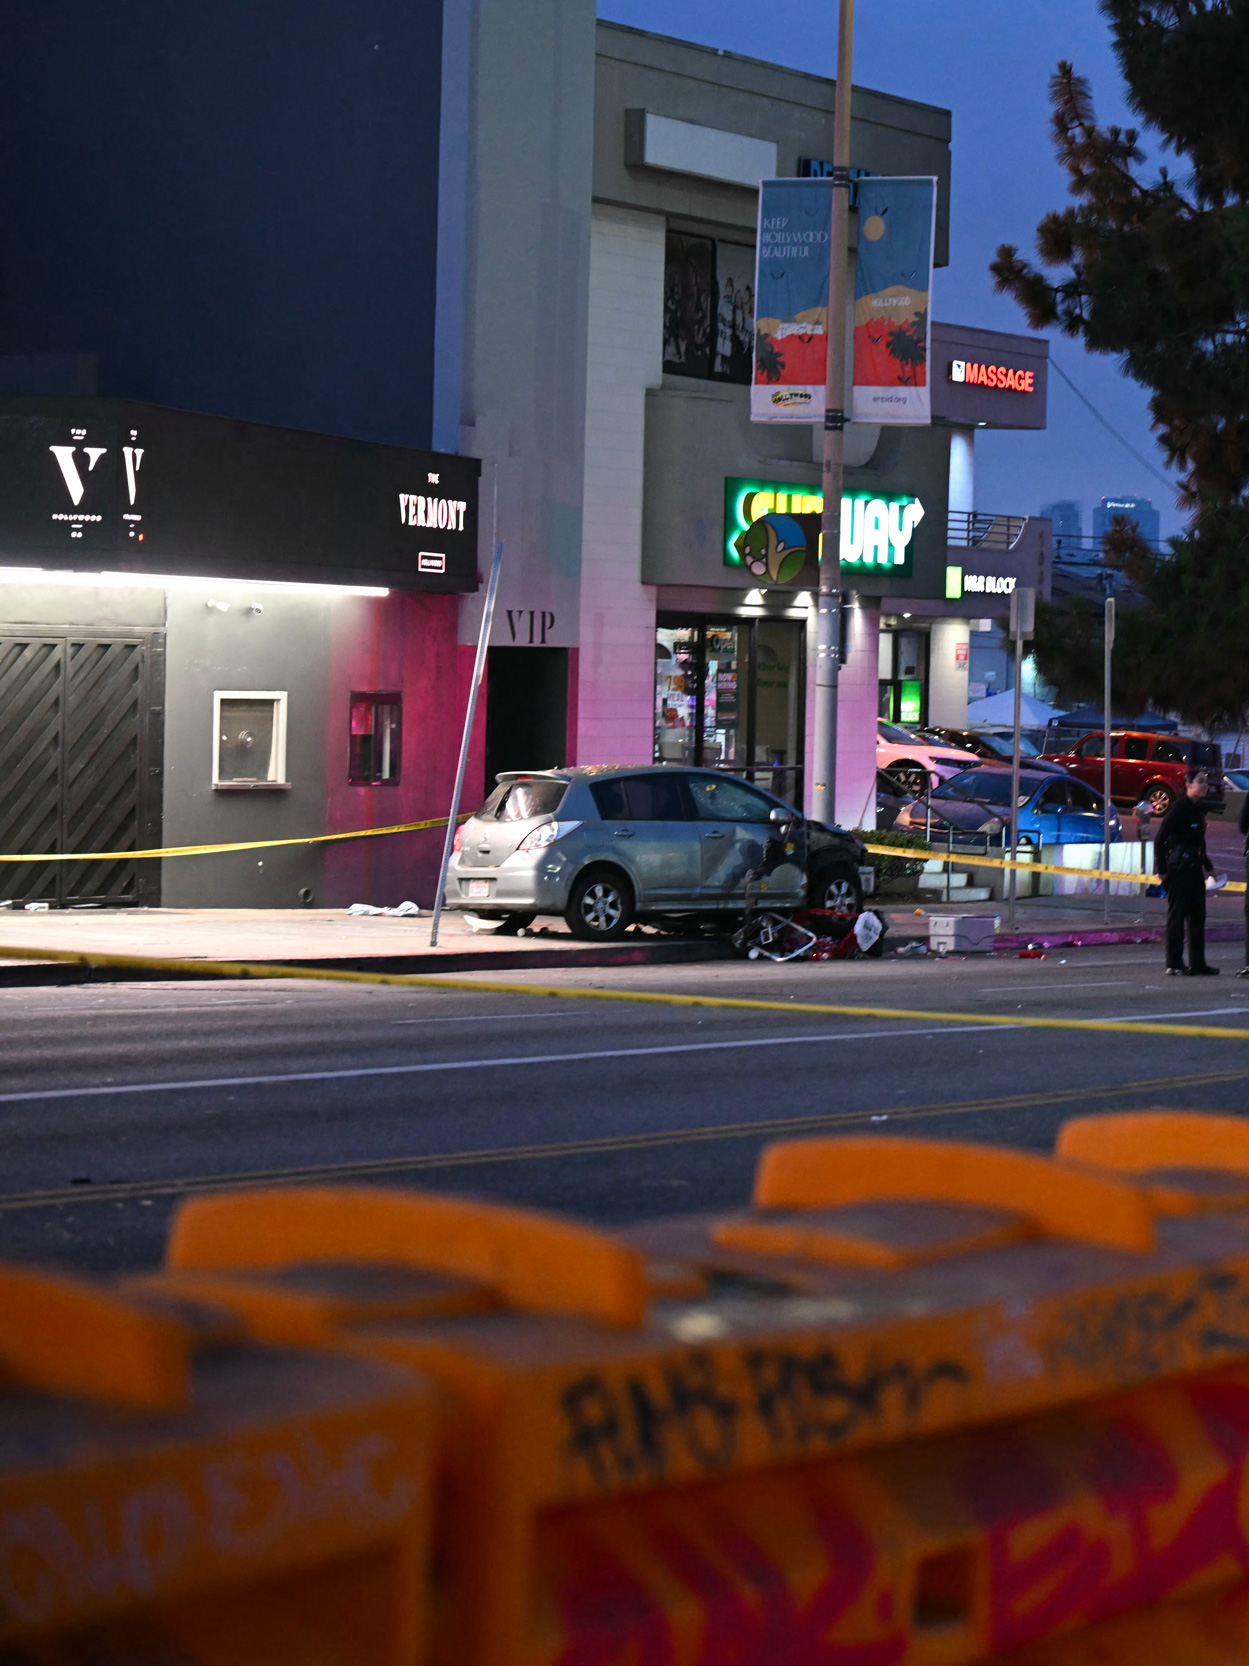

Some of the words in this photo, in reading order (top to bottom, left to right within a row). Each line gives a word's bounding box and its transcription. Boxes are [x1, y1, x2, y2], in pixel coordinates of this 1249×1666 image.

[762, 230, 829, 244] HOLLYWOOD
[763, 217, 789, 230] KEEP
[872, 296, 911, 308] HOLLYWOOD
[965, 361, 1035, 393] MASSAGE
[49, 445, 107, 506] V
[398, 493, 467, 531] VERMONT
[734, 491, 925, 565] WAY
[985, 575, 1017, 594] BLOCK
[505, 609, 555, 644] VIP
